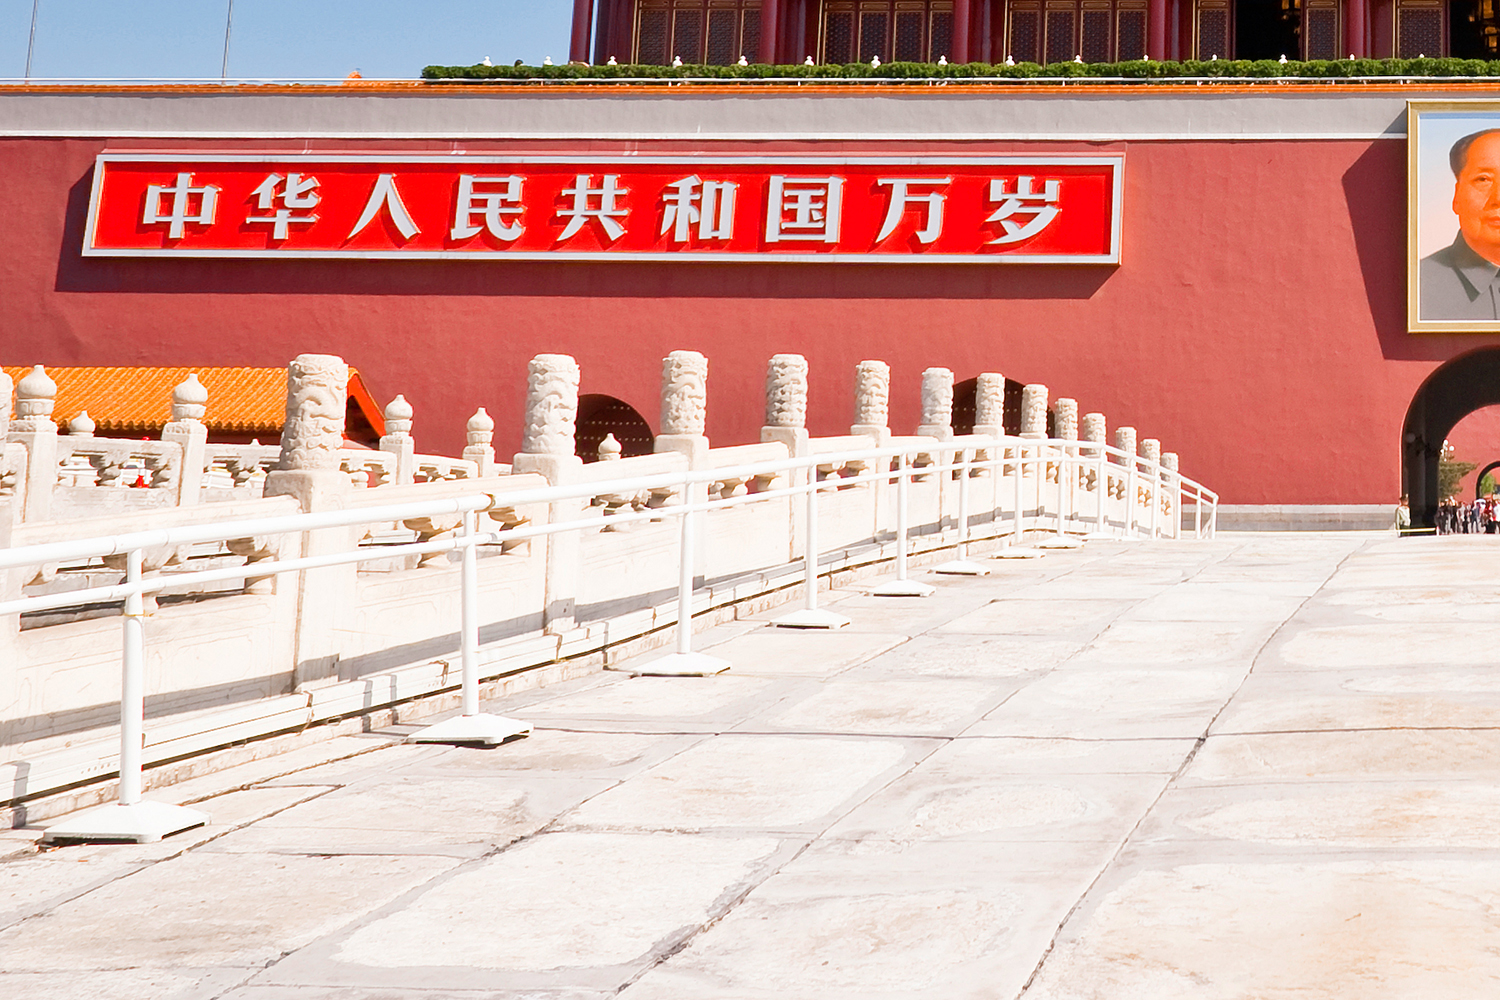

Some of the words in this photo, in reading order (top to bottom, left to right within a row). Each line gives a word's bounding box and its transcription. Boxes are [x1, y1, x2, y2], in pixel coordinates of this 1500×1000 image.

[142, 172, 1060, 244] 中华人民共和国万岁
